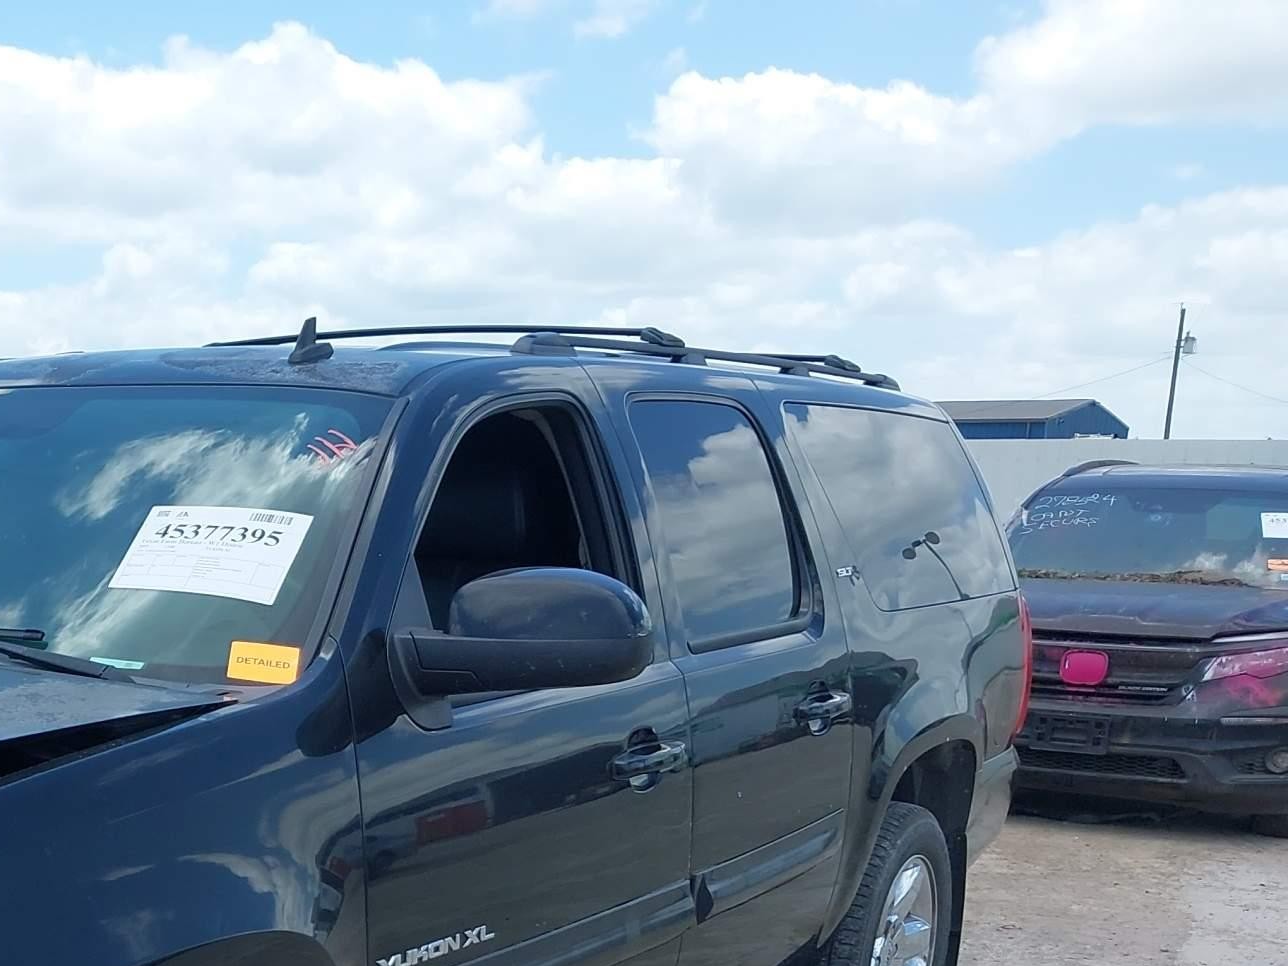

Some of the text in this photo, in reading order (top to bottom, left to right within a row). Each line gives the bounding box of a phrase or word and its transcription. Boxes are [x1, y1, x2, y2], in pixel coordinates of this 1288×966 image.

[155, 523, 284, 547] 45377395
[236, 655, 291, 670] DETAILED
[462, 925, 496, 949] XL
